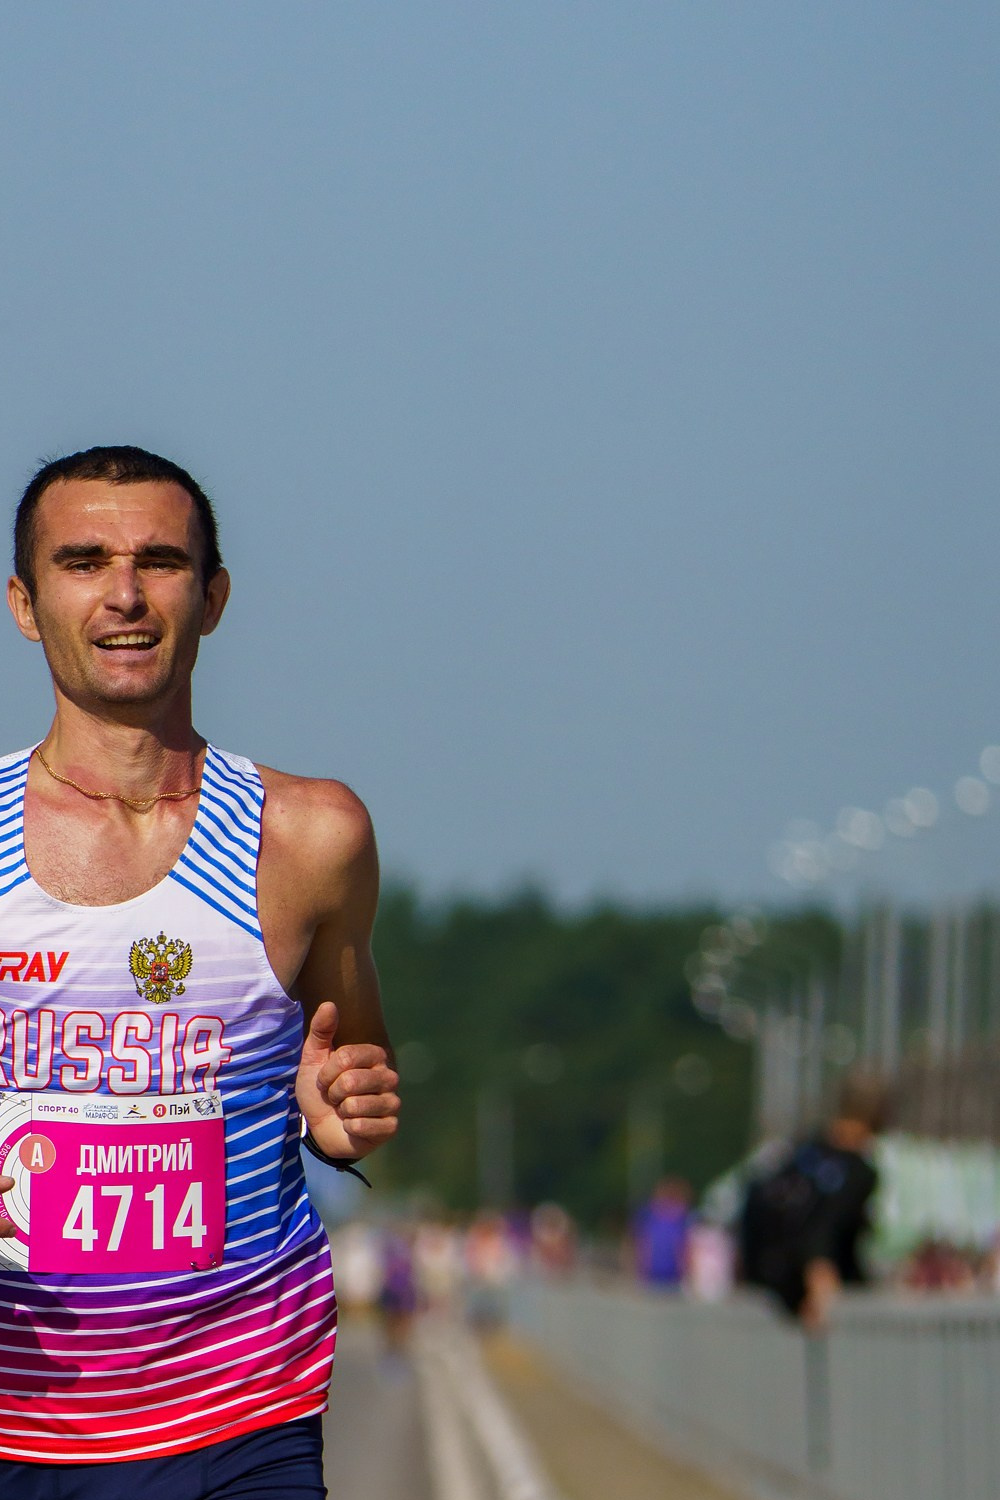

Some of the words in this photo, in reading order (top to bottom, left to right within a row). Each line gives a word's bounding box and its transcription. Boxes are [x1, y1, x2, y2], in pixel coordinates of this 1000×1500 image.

[37, 1105, 67, 1113] СПОРТ
[169, 1103, 190, 1116] Пэй
[85, 1112, 118, 1120] МАРАФОН
[76, 1138, 193, 1176] ДМИТРИЙ
[62, 1181, 207, 1252] 4714
